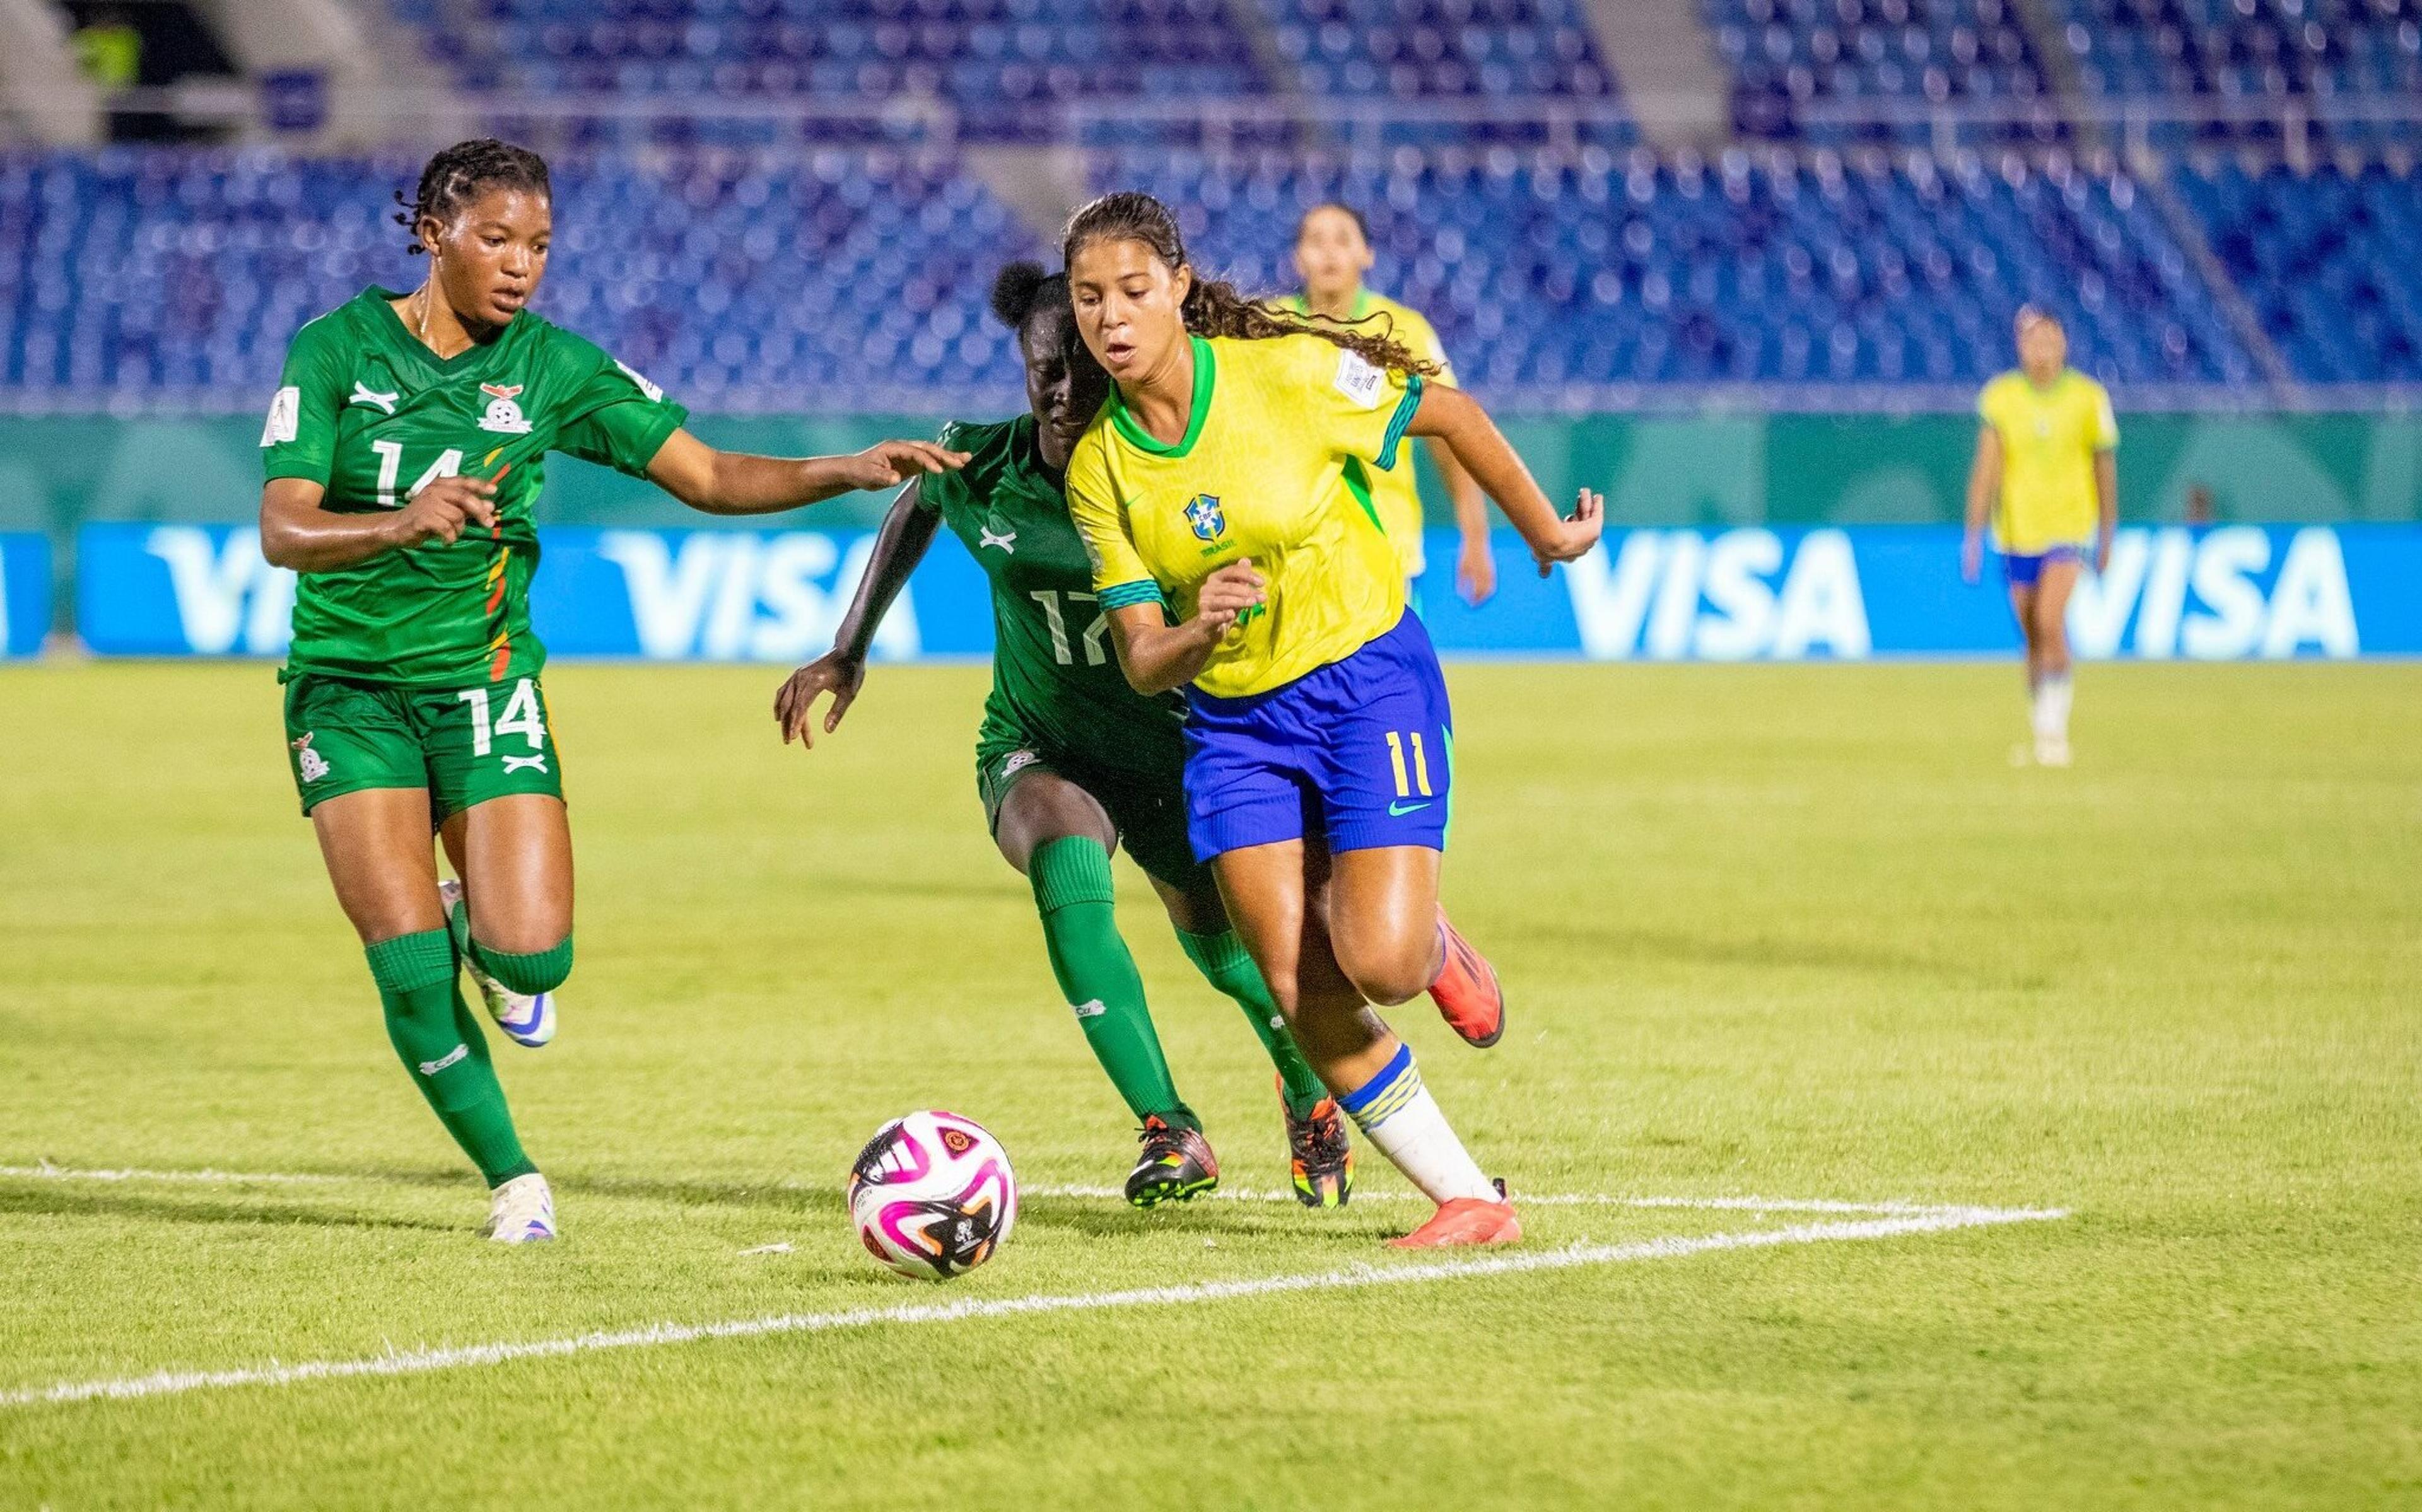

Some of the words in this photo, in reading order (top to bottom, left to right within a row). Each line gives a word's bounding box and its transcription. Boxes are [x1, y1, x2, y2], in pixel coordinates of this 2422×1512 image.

[1200, 539, 1237, 557] BRASIL
[1552, 528, 1871, 661] VISA
[2066, 526, 2359, 660] VISA
[458, 678, 547, 757] 14
[1385, 731, 1433, 797] 11
